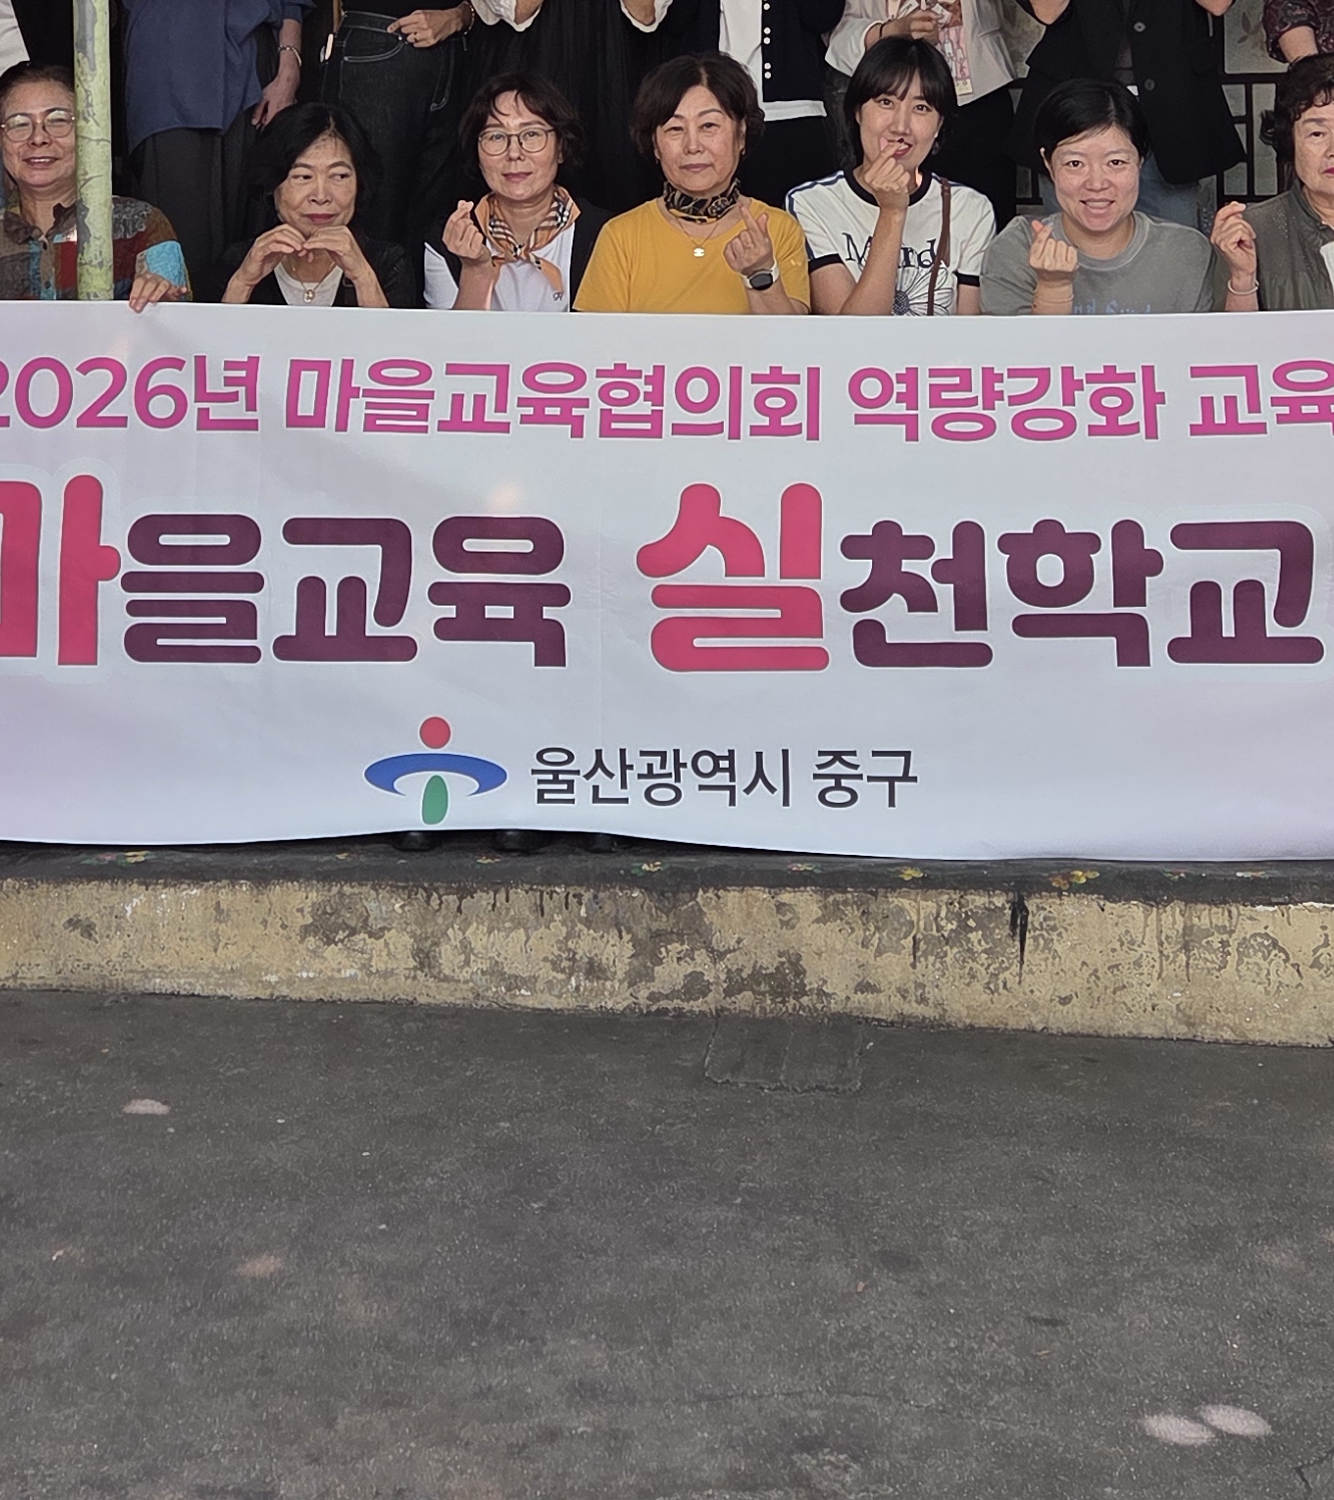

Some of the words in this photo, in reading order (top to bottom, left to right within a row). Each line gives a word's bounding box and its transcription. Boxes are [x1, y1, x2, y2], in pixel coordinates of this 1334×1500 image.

[841, 232, 938, 269] Mrd
[286, 359, 820, 440] 마을교육협의회
[848, 365, 1165, 441] 역량강화
[636, 483, 1321, 671] 실천학교
[531, 747, 790, 810] 울산광역시
[812, 749, 918, 810] 중구
